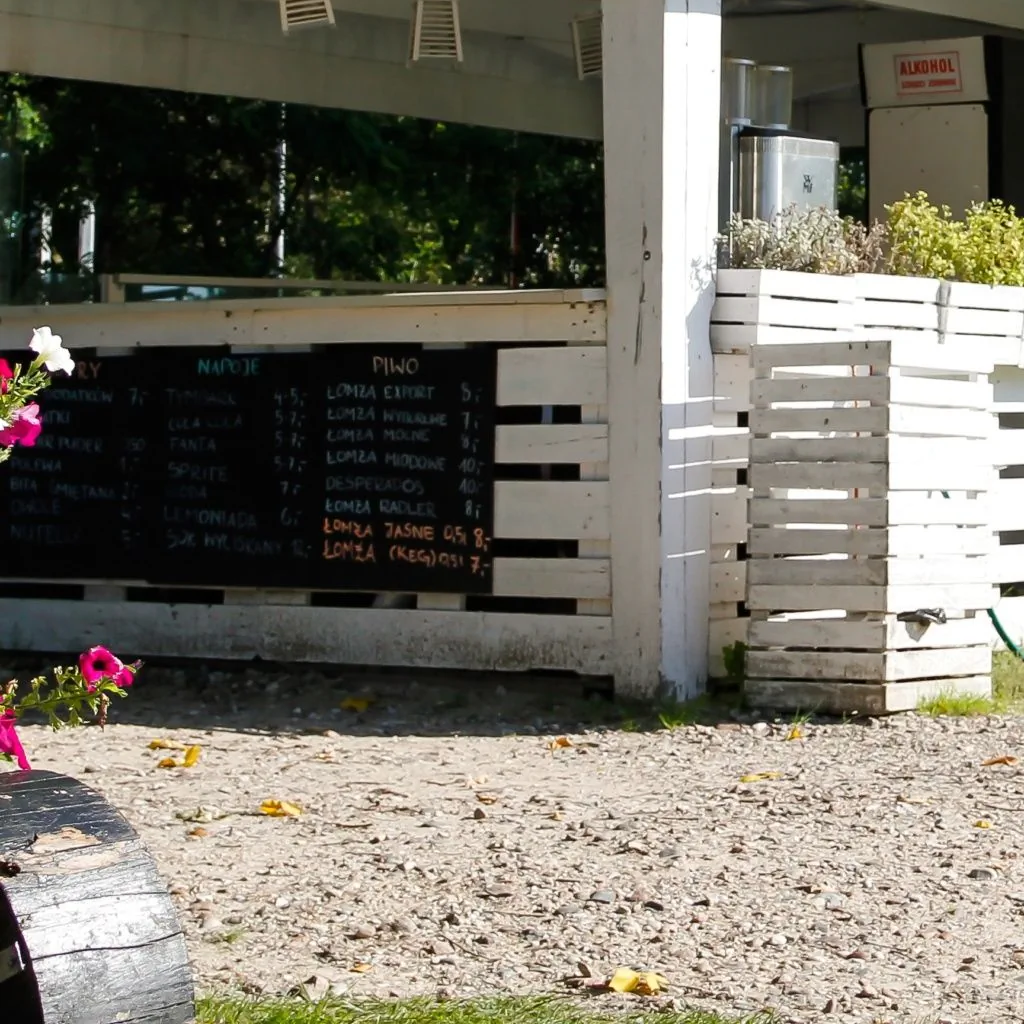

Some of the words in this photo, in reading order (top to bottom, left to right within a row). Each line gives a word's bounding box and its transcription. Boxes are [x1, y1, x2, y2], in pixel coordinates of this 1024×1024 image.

[900, 58, 956, 75] ALKOHOL
[197, 357, 260, 376] NAPOJE
[372, 355, 420, 376] PIWO
[383, 383, 436, 401] EXPORT
[169, 436, 217, 453] FANTA
[168, 460, 228, 482] SPRITE
[326, 475, 425, 496] DESPERADOS
[379, 499, 438, 519] RADLER
[384, 522, 435, 541] JASNE
[388, 544, 436, 567] (KEG)
